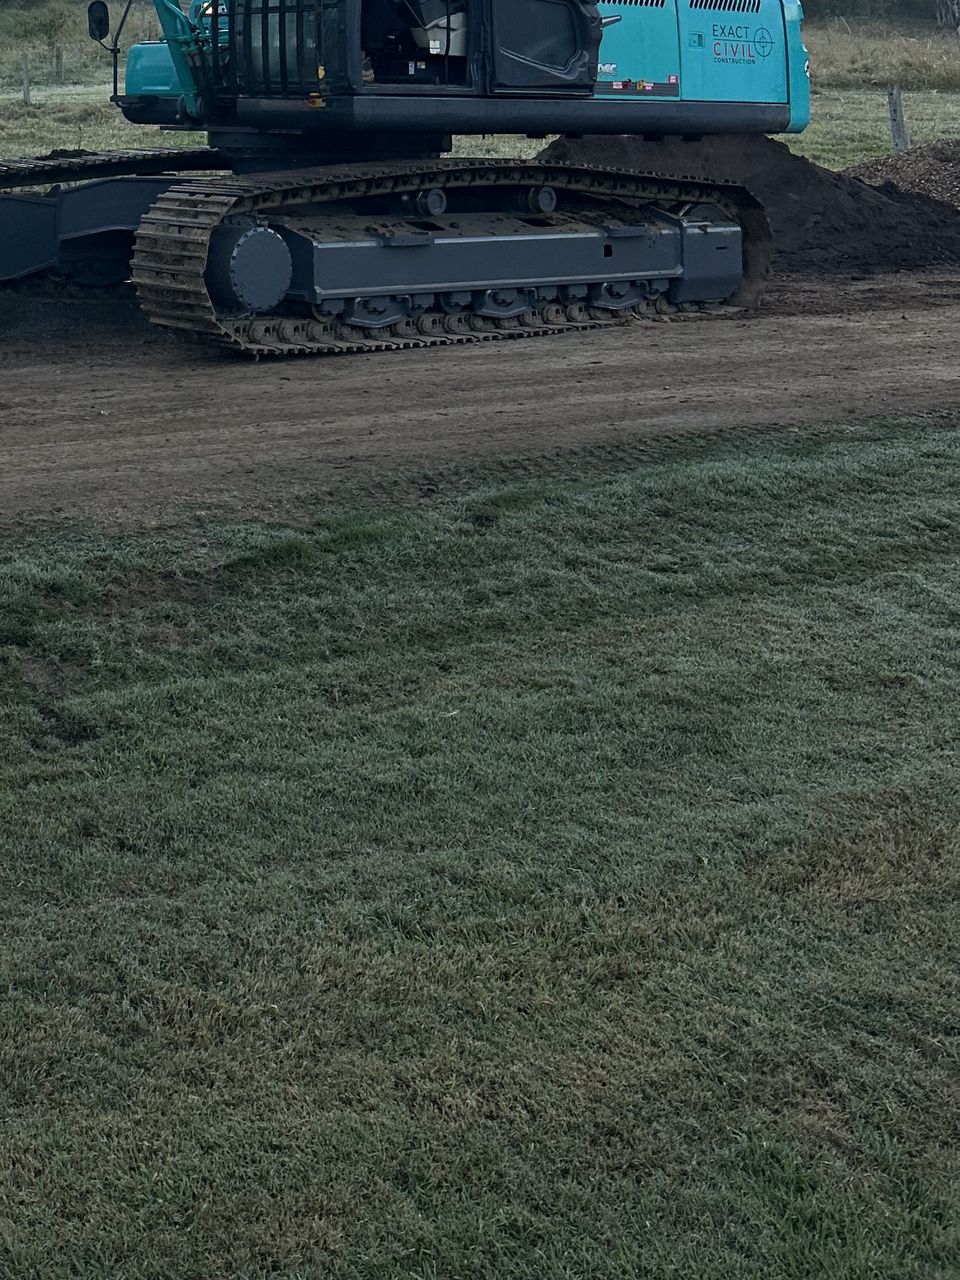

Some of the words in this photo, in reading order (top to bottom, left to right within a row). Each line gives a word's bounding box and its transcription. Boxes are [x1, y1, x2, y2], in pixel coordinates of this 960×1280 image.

[712, 24, 749, 39] EXACT
[713, 42, 755, 58] CIVIL
[713, 57, 756, 65] CONSTRUCTION
